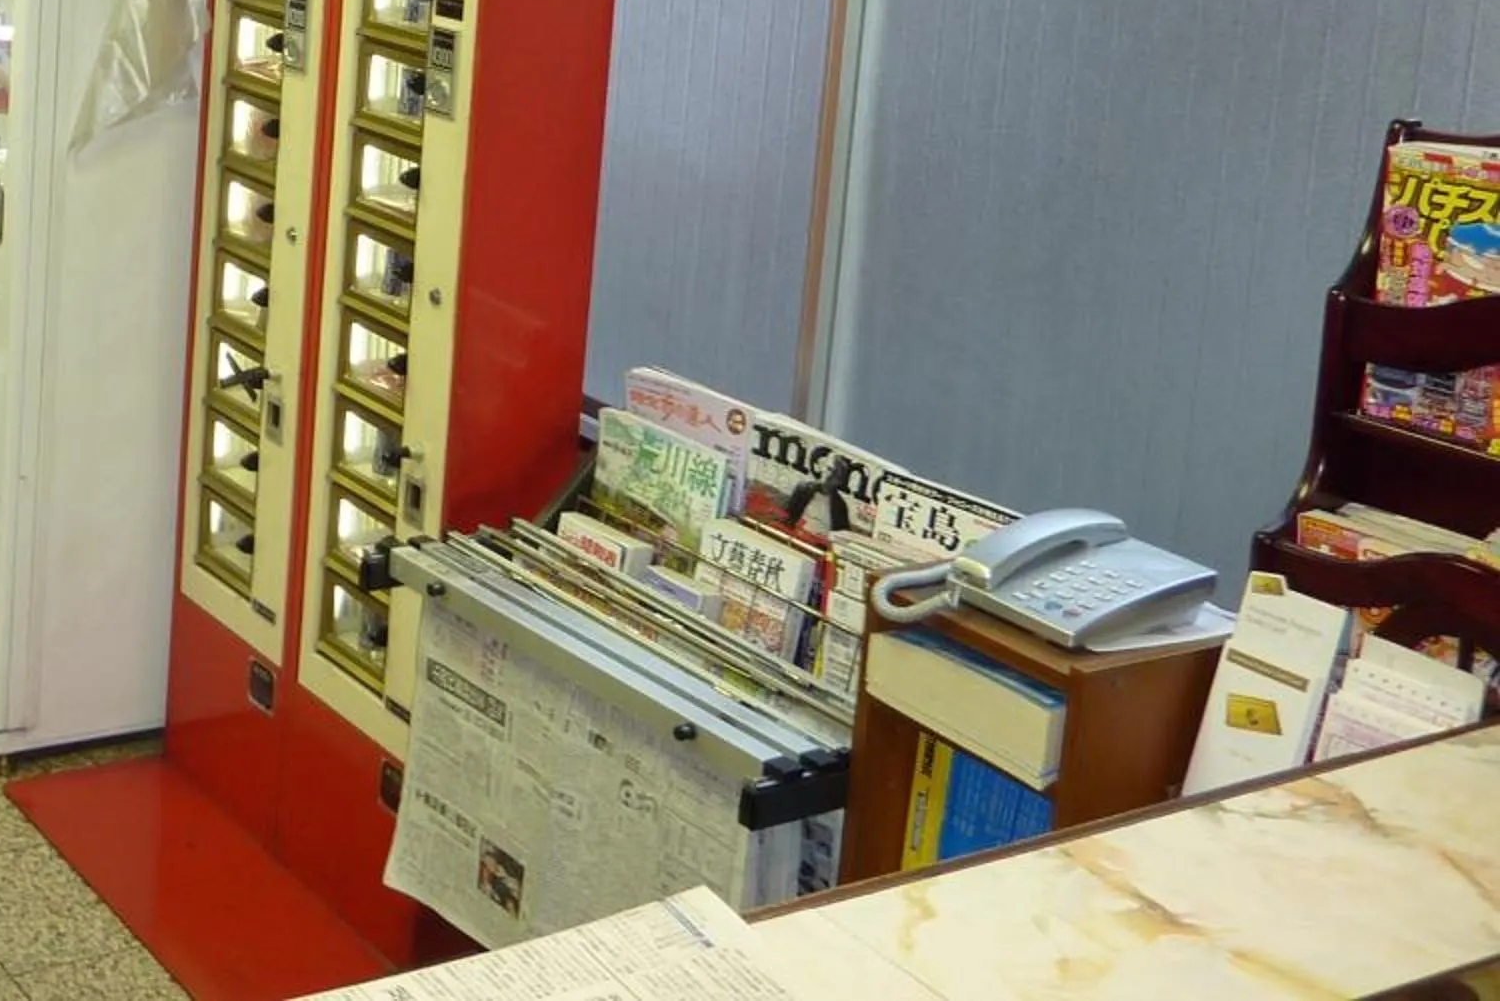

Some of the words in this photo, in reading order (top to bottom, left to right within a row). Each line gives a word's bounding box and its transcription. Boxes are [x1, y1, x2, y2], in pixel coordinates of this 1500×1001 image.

[1389, 171, 1500, 225] パチス
[634, 429, 719, 499] 荒川線
[709, 532, 786, 593] 文藝春秋
